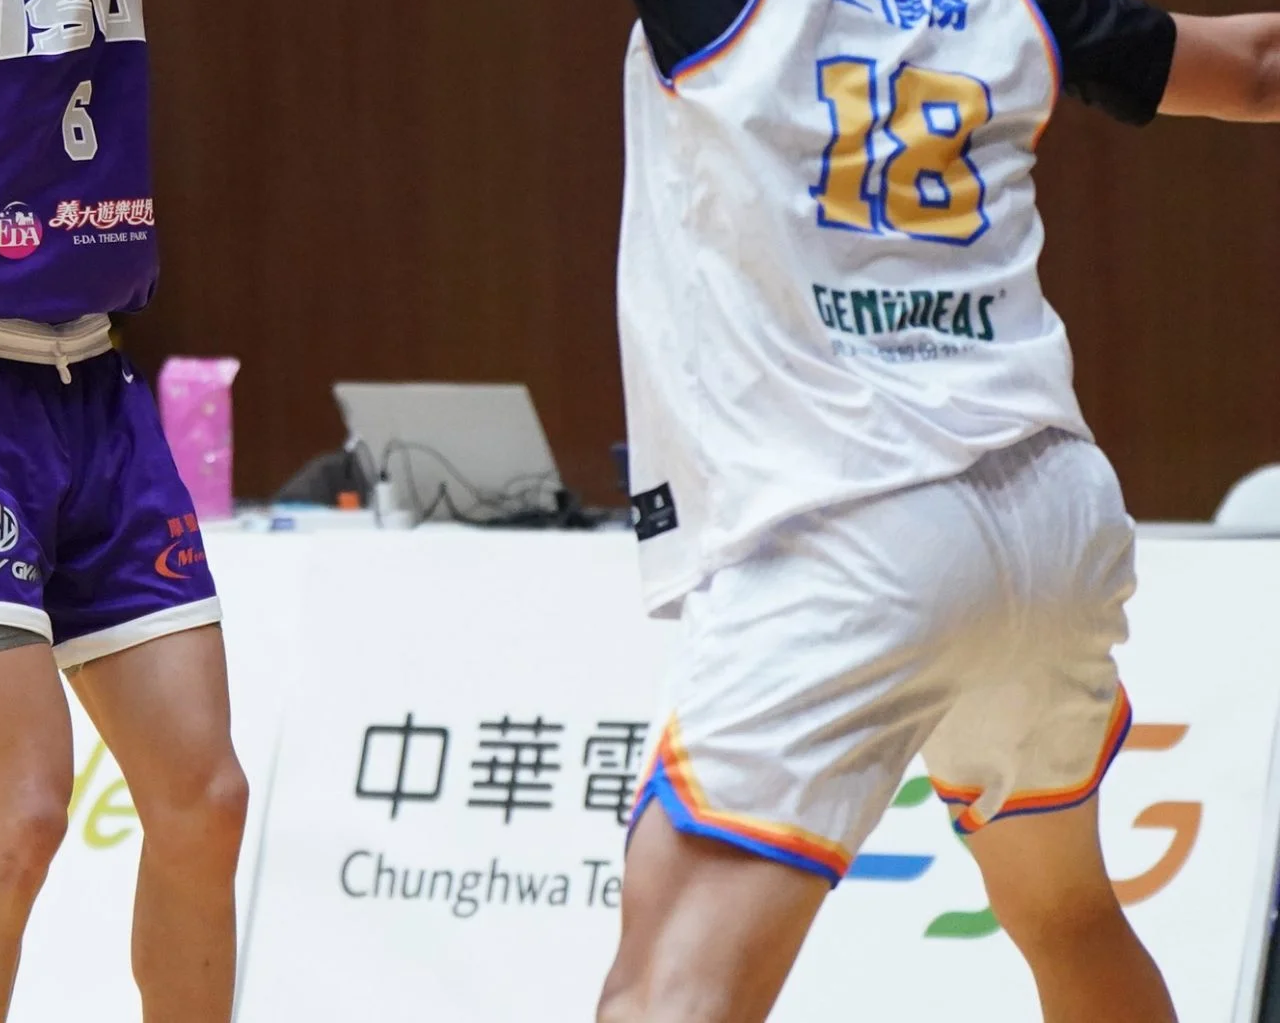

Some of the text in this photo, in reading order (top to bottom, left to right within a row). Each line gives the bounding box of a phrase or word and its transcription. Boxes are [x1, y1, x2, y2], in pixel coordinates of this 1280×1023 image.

[61, 79, 99, 162] 6
[808, 54, 993, 248] 18
[48, 198, 156, 231] 義大遊樂世界
[73, 231, 148, 245] E-DA THEME PARK
[339, 849, 571, 920] Chunghwa
